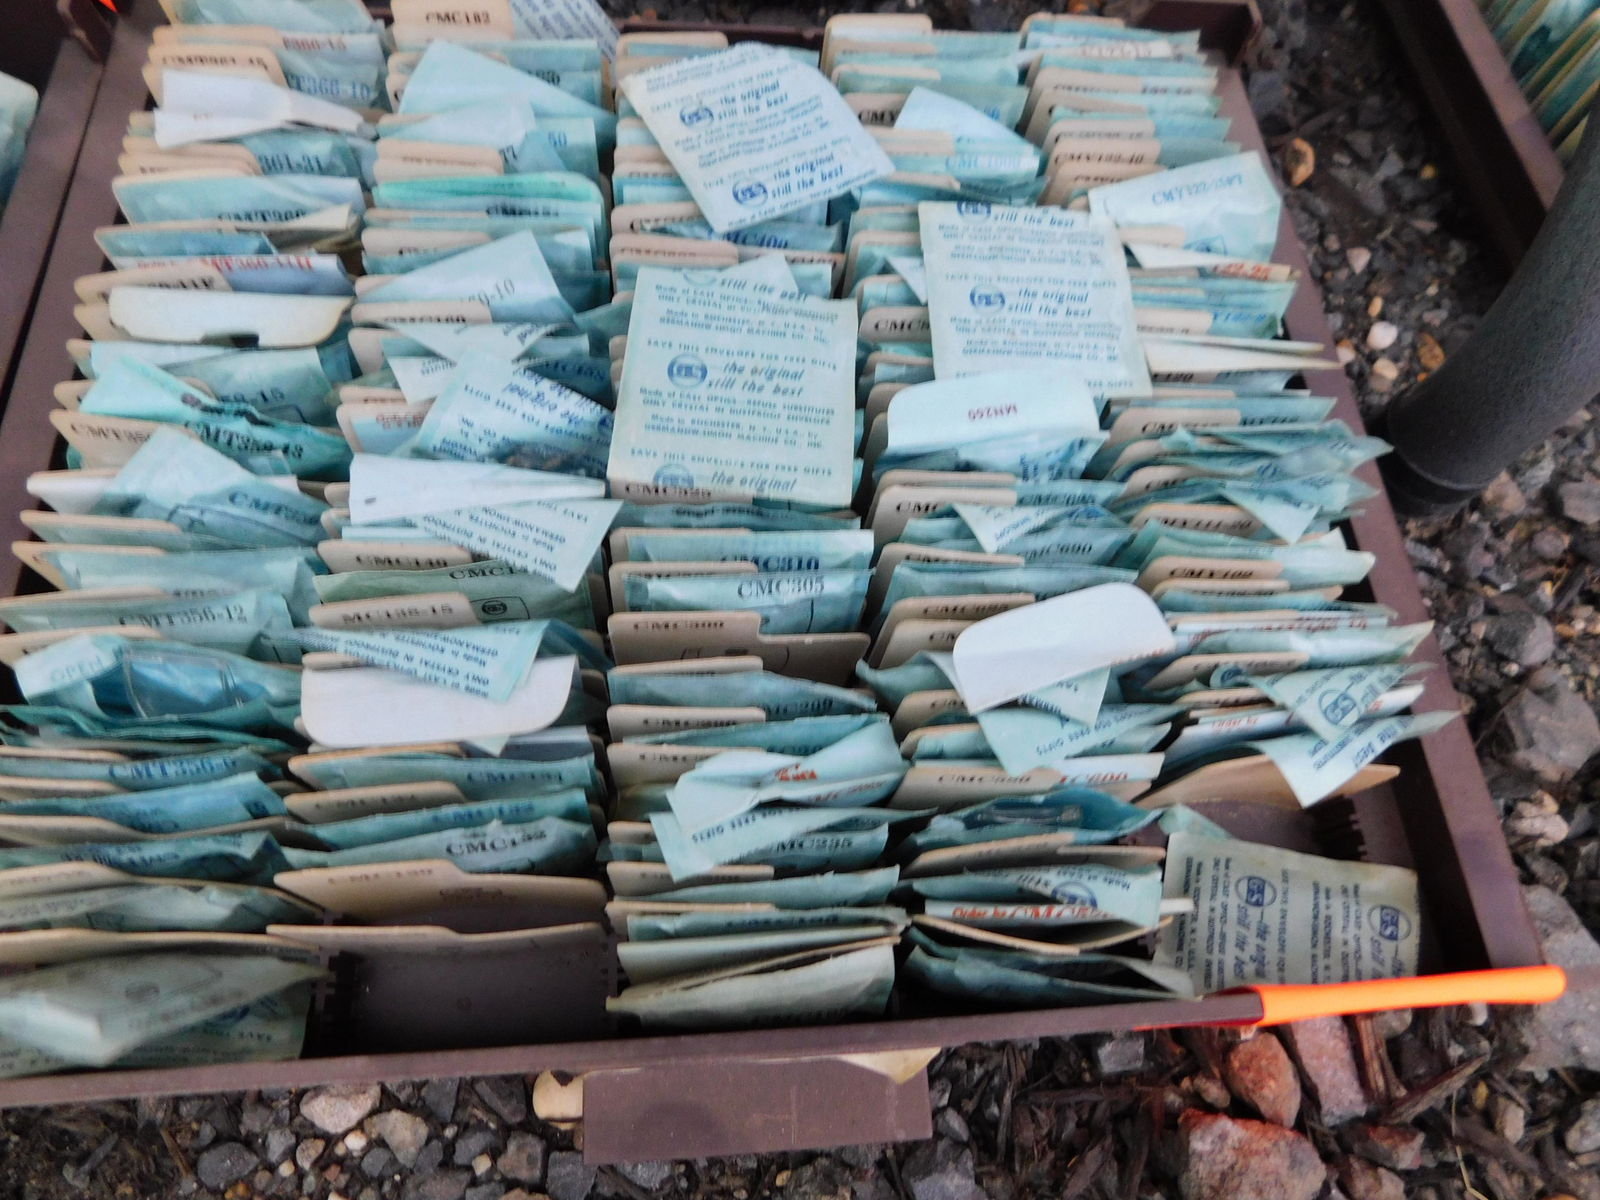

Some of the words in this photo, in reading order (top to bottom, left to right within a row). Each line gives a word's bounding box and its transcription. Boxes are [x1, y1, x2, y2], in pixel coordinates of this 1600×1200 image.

[720, 93, 736, 105] the
[740, 80, 780, 100] original
[718, 108, 737, 120] still
[743, 104, 760, 115] the
[766, 92, 788, 107] best
[773, 168, 790, 181] the
[794, 153, 834, 173] original
[771, 185, 792, 199] still
[797, 177, 814, 190] the
[821, 165, 843, 181] best
[994, 211, 1017, 222] still
[1023, 214, 1042, 224] the
[1050, 216, 1075, 228] best
[721, 278, 746, 290] still
[753, 282, 774, 294] the
[1018, 288, 1037, 299] the
[1043, 289, 1089, 305] original
[1008, 302, 1033, 313] still
[1038, 304, 1058, 316] the
[1065, 306, 1092, 318] best
[723, 360, 746, 375] the
[750, 365, 805, 382] original
[706, 375, 734, 389] still
[742, 378, 766, 393] the
[772, 382, 804, 397] best
[711, 471, 734, 486] the
[740, 475, 798, 492] original
[737, 575, 825, 598] CMC305
[1234, 930, 1249, 952] the
